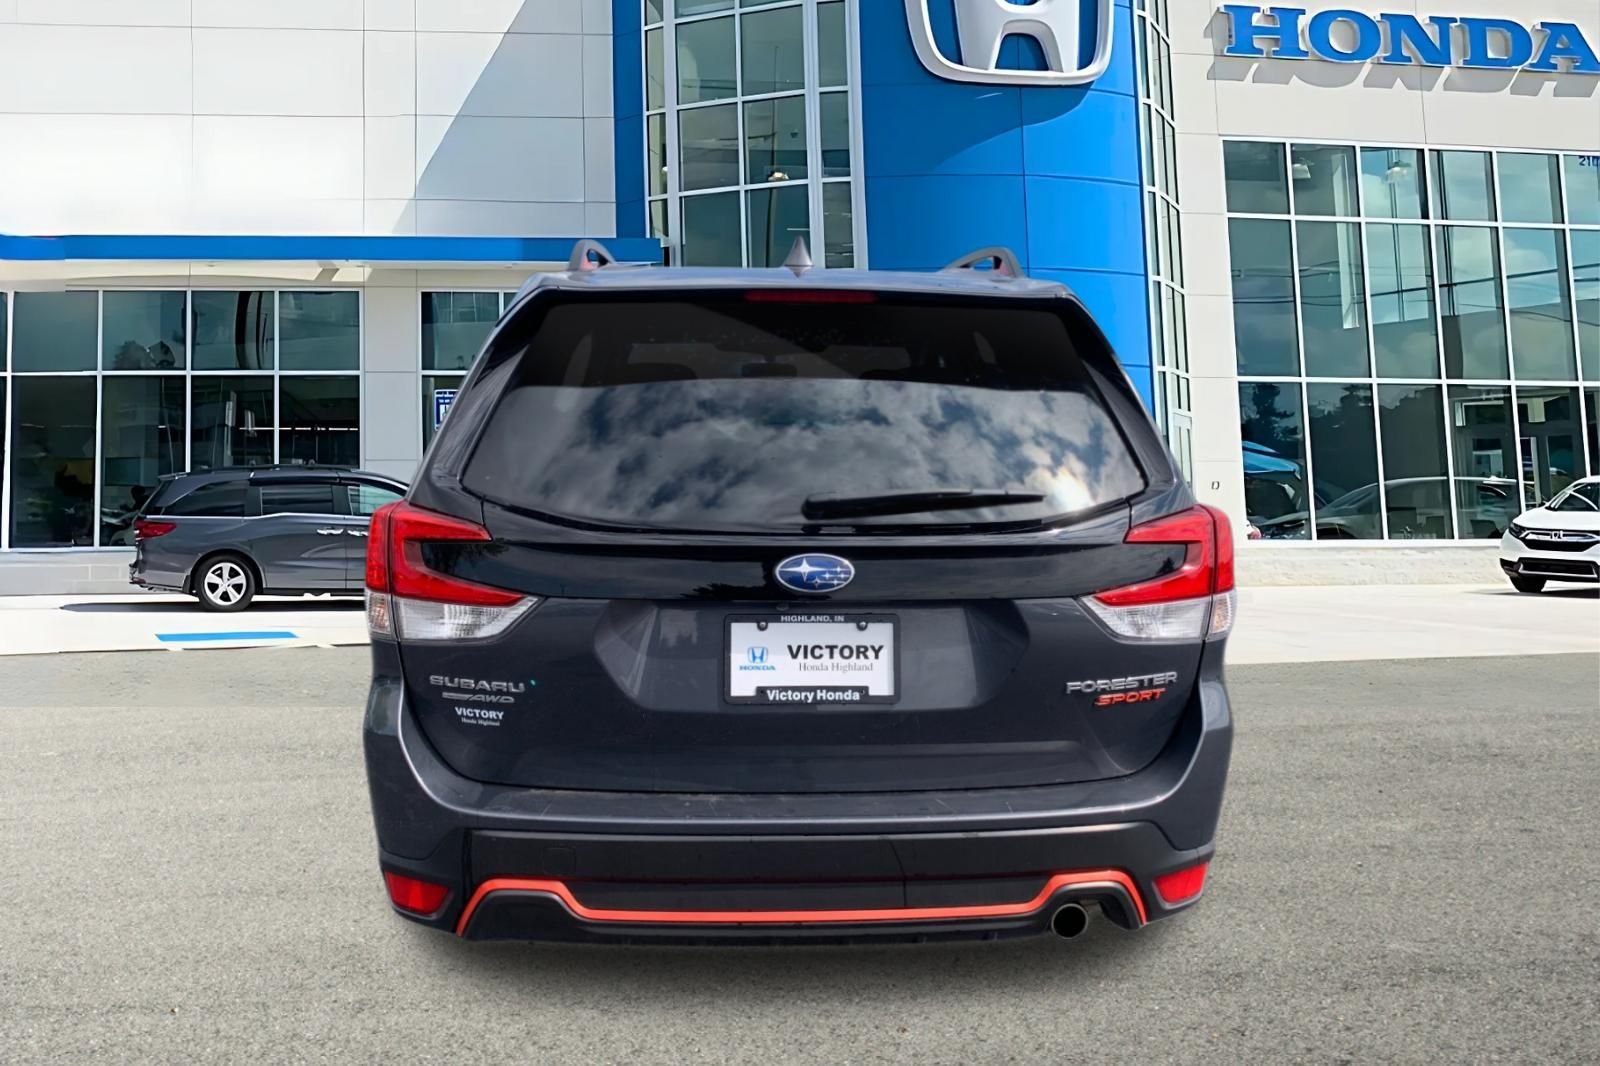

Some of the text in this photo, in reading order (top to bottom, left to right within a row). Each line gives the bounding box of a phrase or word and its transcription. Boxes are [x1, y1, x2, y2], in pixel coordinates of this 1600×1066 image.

[1222, 4, 1600, 74] HONDA
[787, 644, 884, 660] VICTORY
[799, 662, 873, 674] Honda Highland
[429, 675, 525, 693] SUBARU
[1066, 671, 1177, 694] FORESTER
[469, 693, 515, 704] AWD
[767, 690, 860, 703] Victory Honda
[1094, 687, 1166, 706] SPORT
[454, 706, 504, 720] VICTORY
